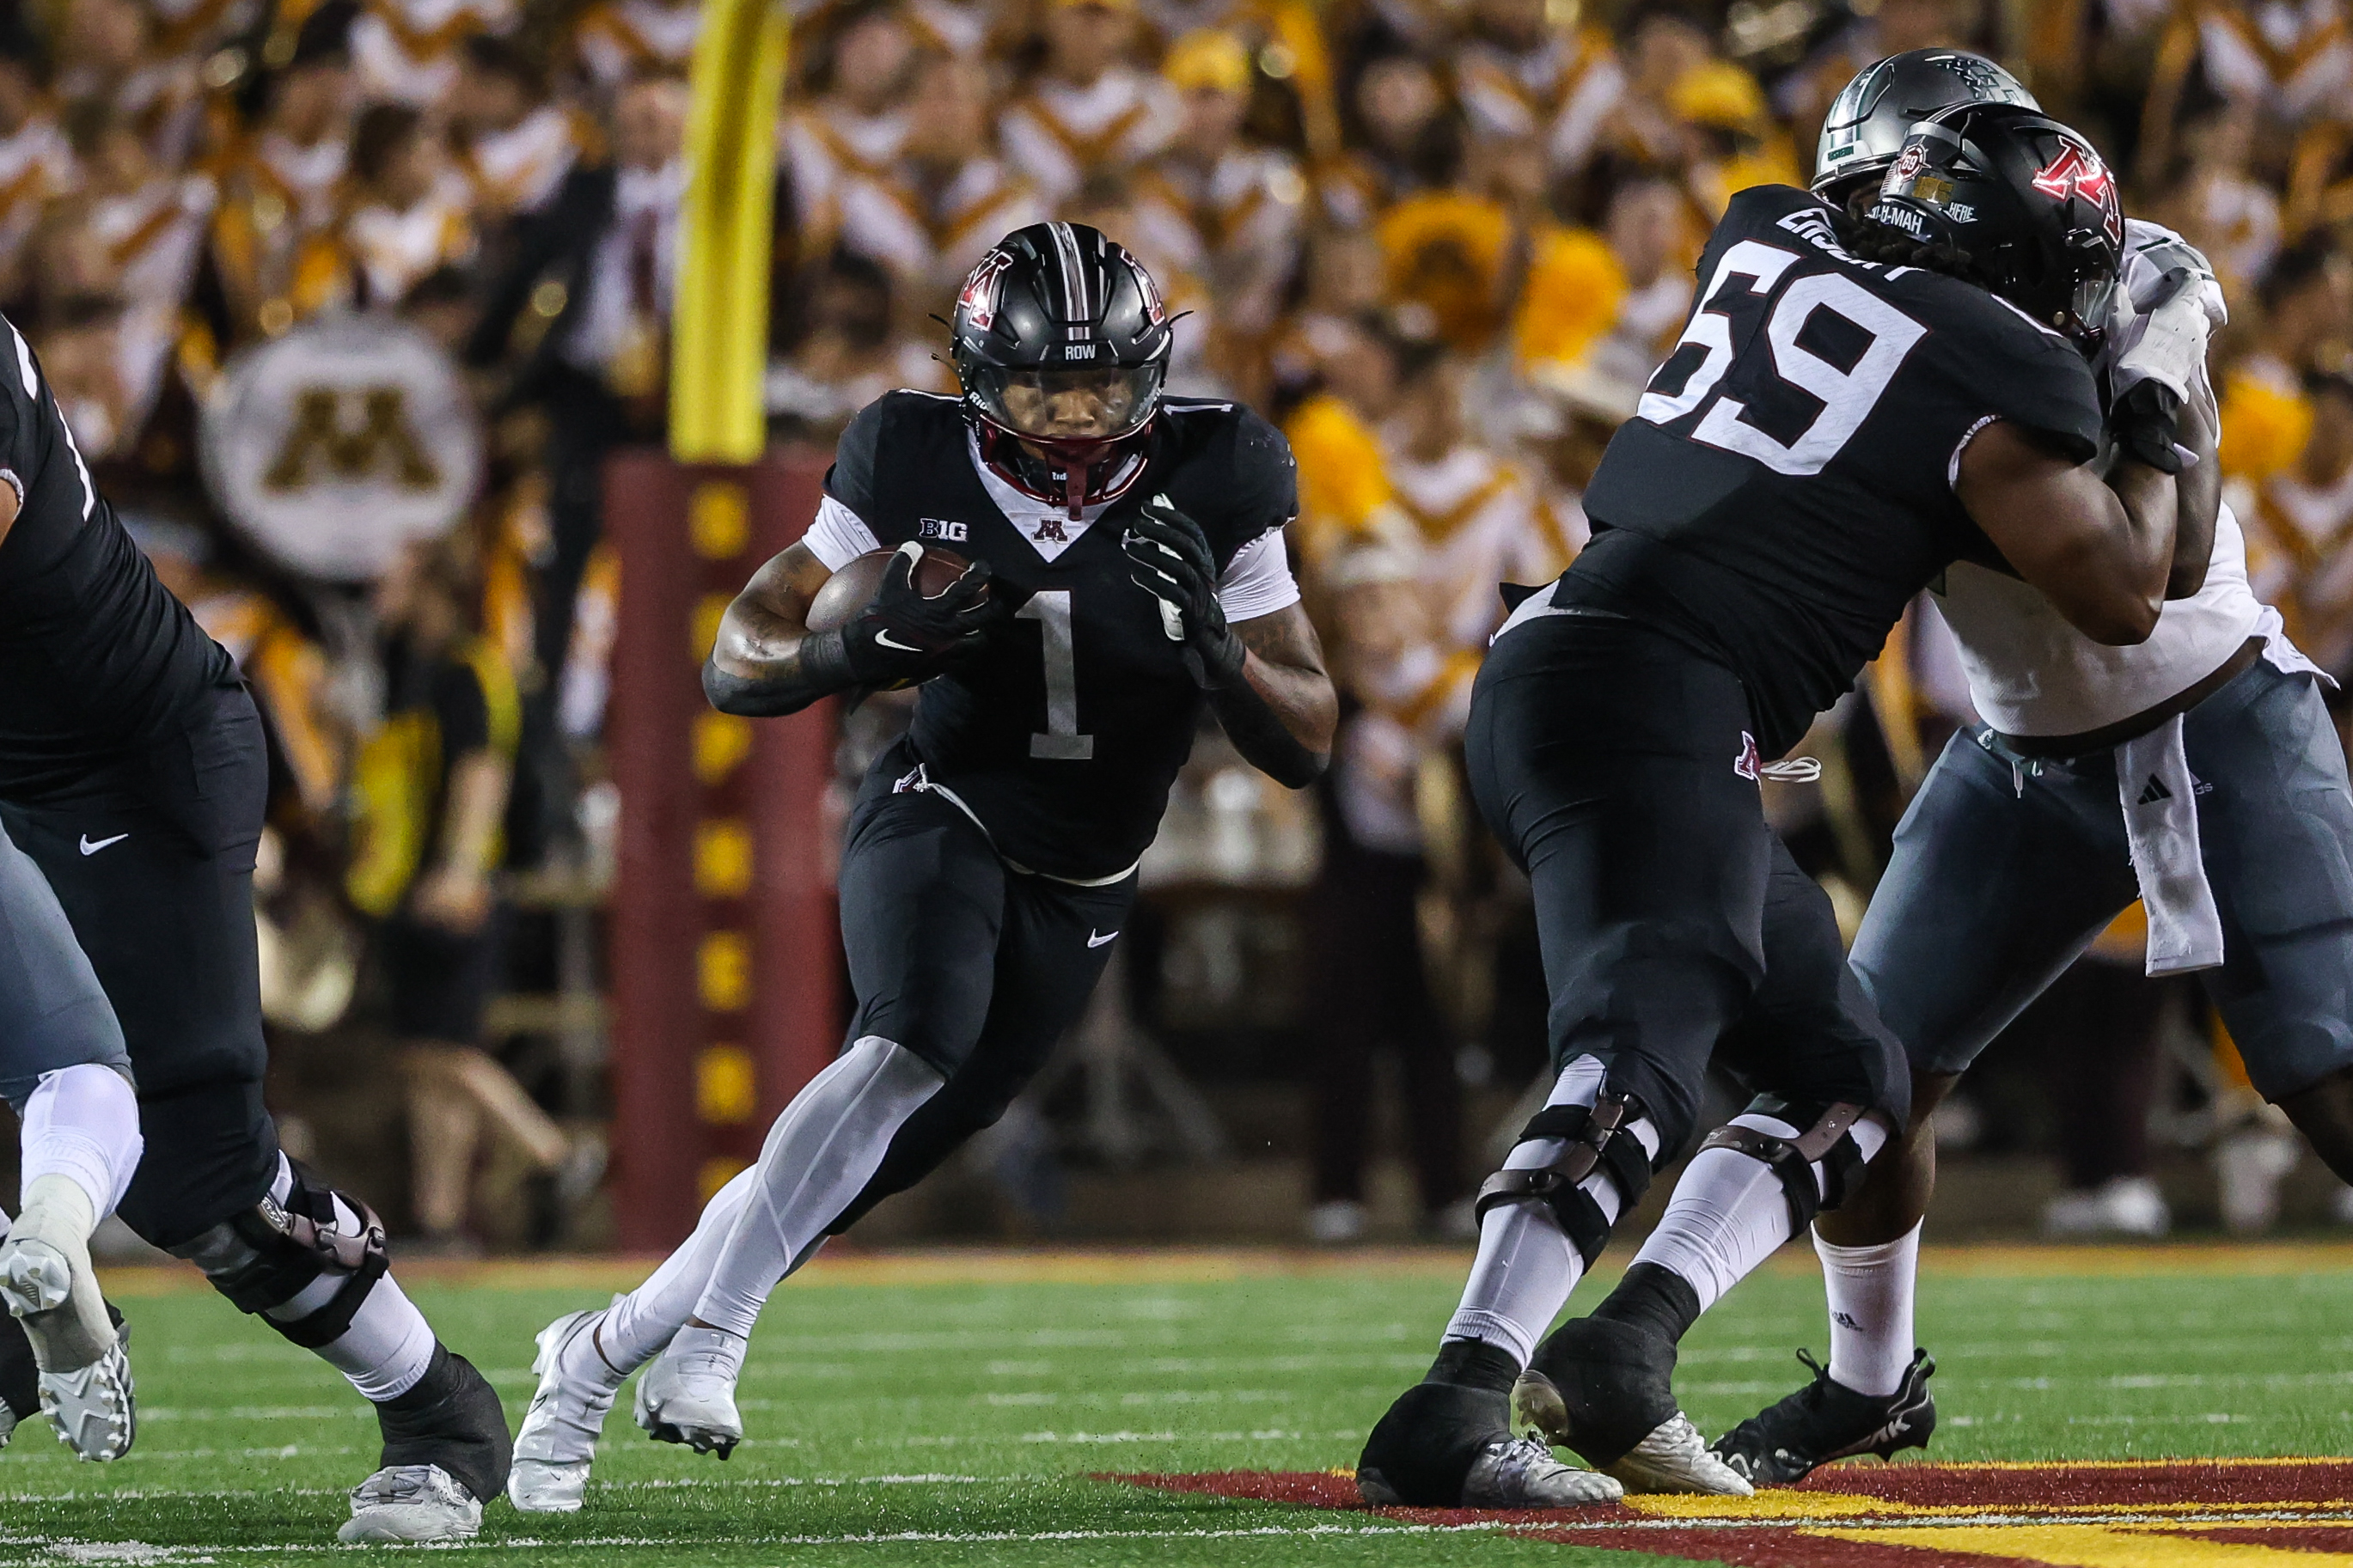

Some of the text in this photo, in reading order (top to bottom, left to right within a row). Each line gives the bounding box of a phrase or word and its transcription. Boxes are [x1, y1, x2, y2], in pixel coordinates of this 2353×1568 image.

[1901, 154, 1918, 170] 69
[2032, 135, 2122, 247] M
[1949, 202, 1975, 223] HERE
[1065, 345, 1096, 360] ROW
[1636, 238, 1932, 476] 69
[264, 387, 442, 493] M
[1033, 519, 1068, 543] M
[1014, 589, 1094, 760] 1
